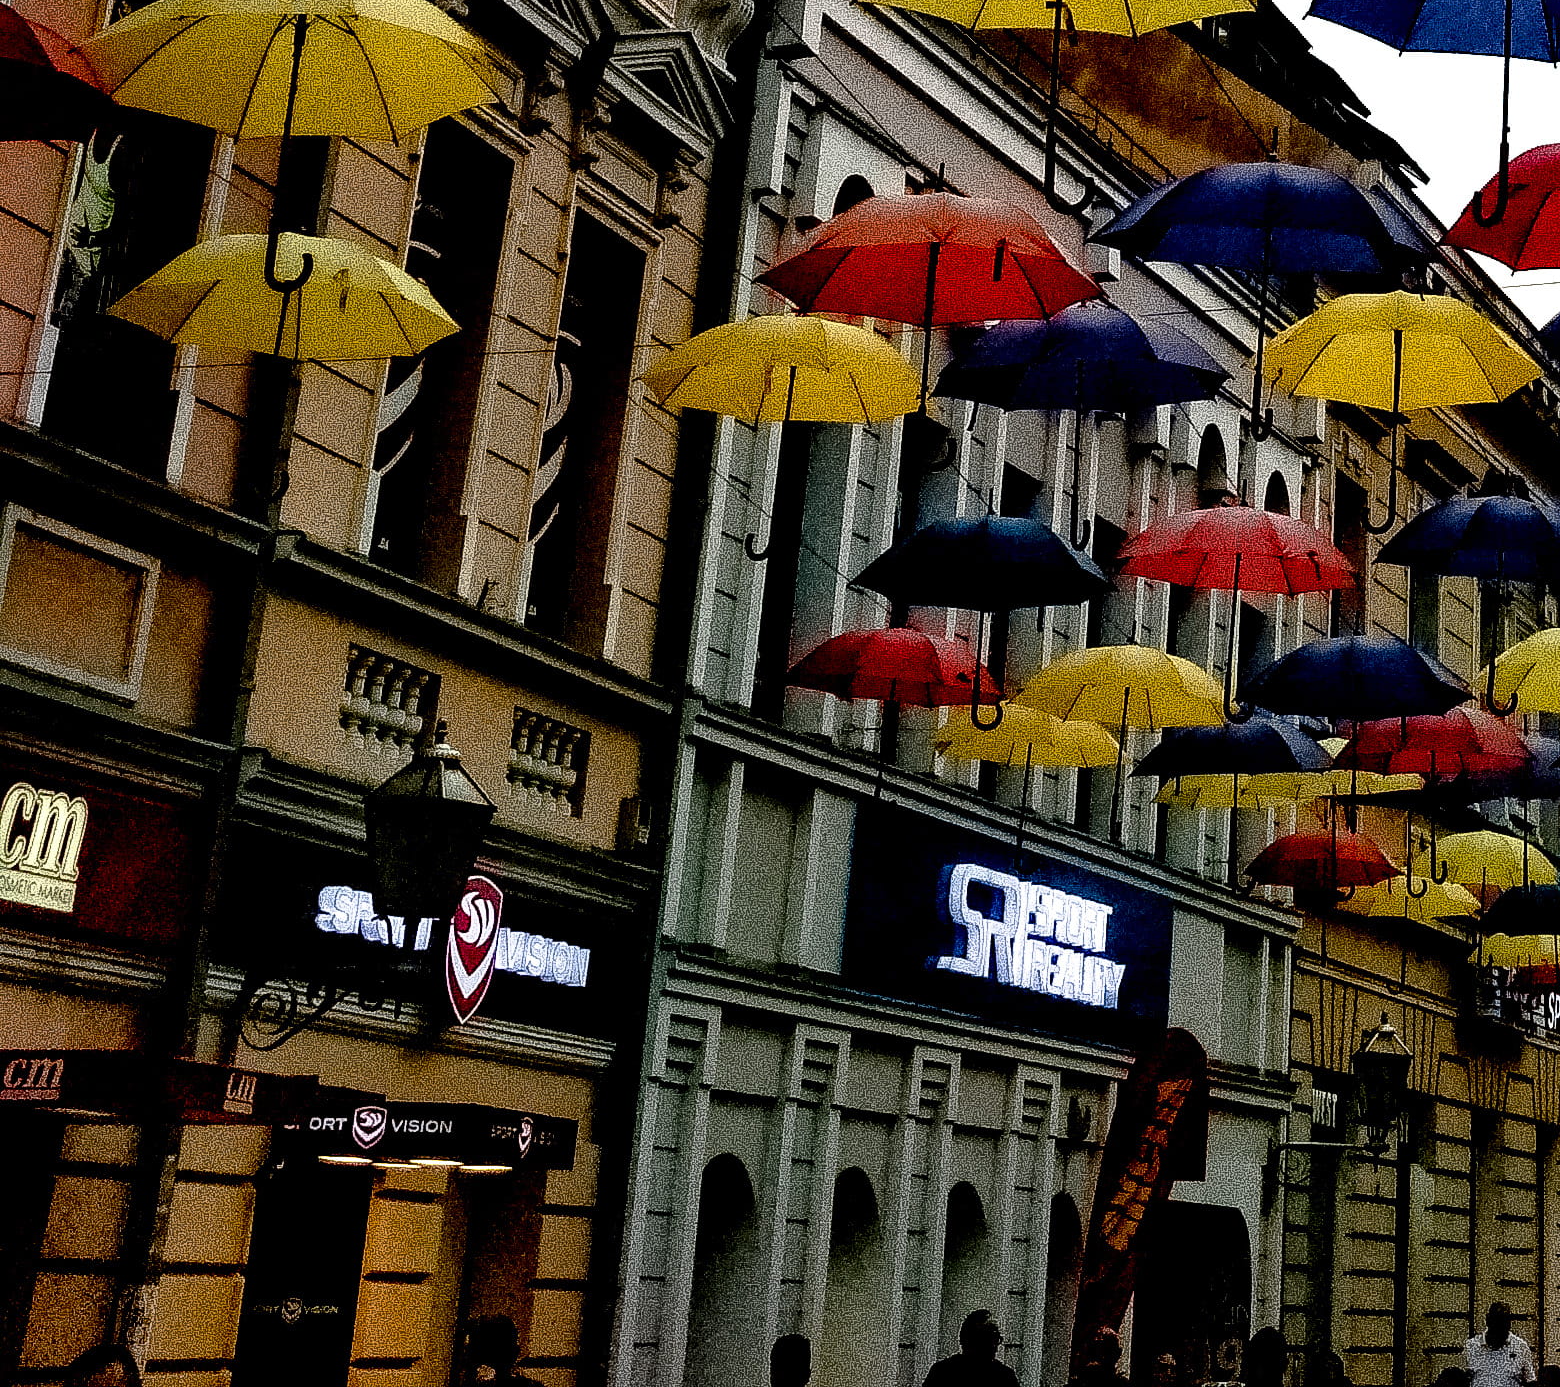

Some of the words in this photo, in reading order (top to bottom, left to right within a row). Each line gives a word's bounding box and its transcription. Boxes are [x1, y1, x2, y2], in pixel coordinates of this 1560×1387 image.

[0, 781, 89, 883] cm
[1028, 883, 1114, 952] SPORT
[497, 927, 591, 988] VISION
[1021, 938, 1127, 1009] REALITY
[3, 1058, 64, 1089] cm
[391, 1119, 453, 1134] VISION
